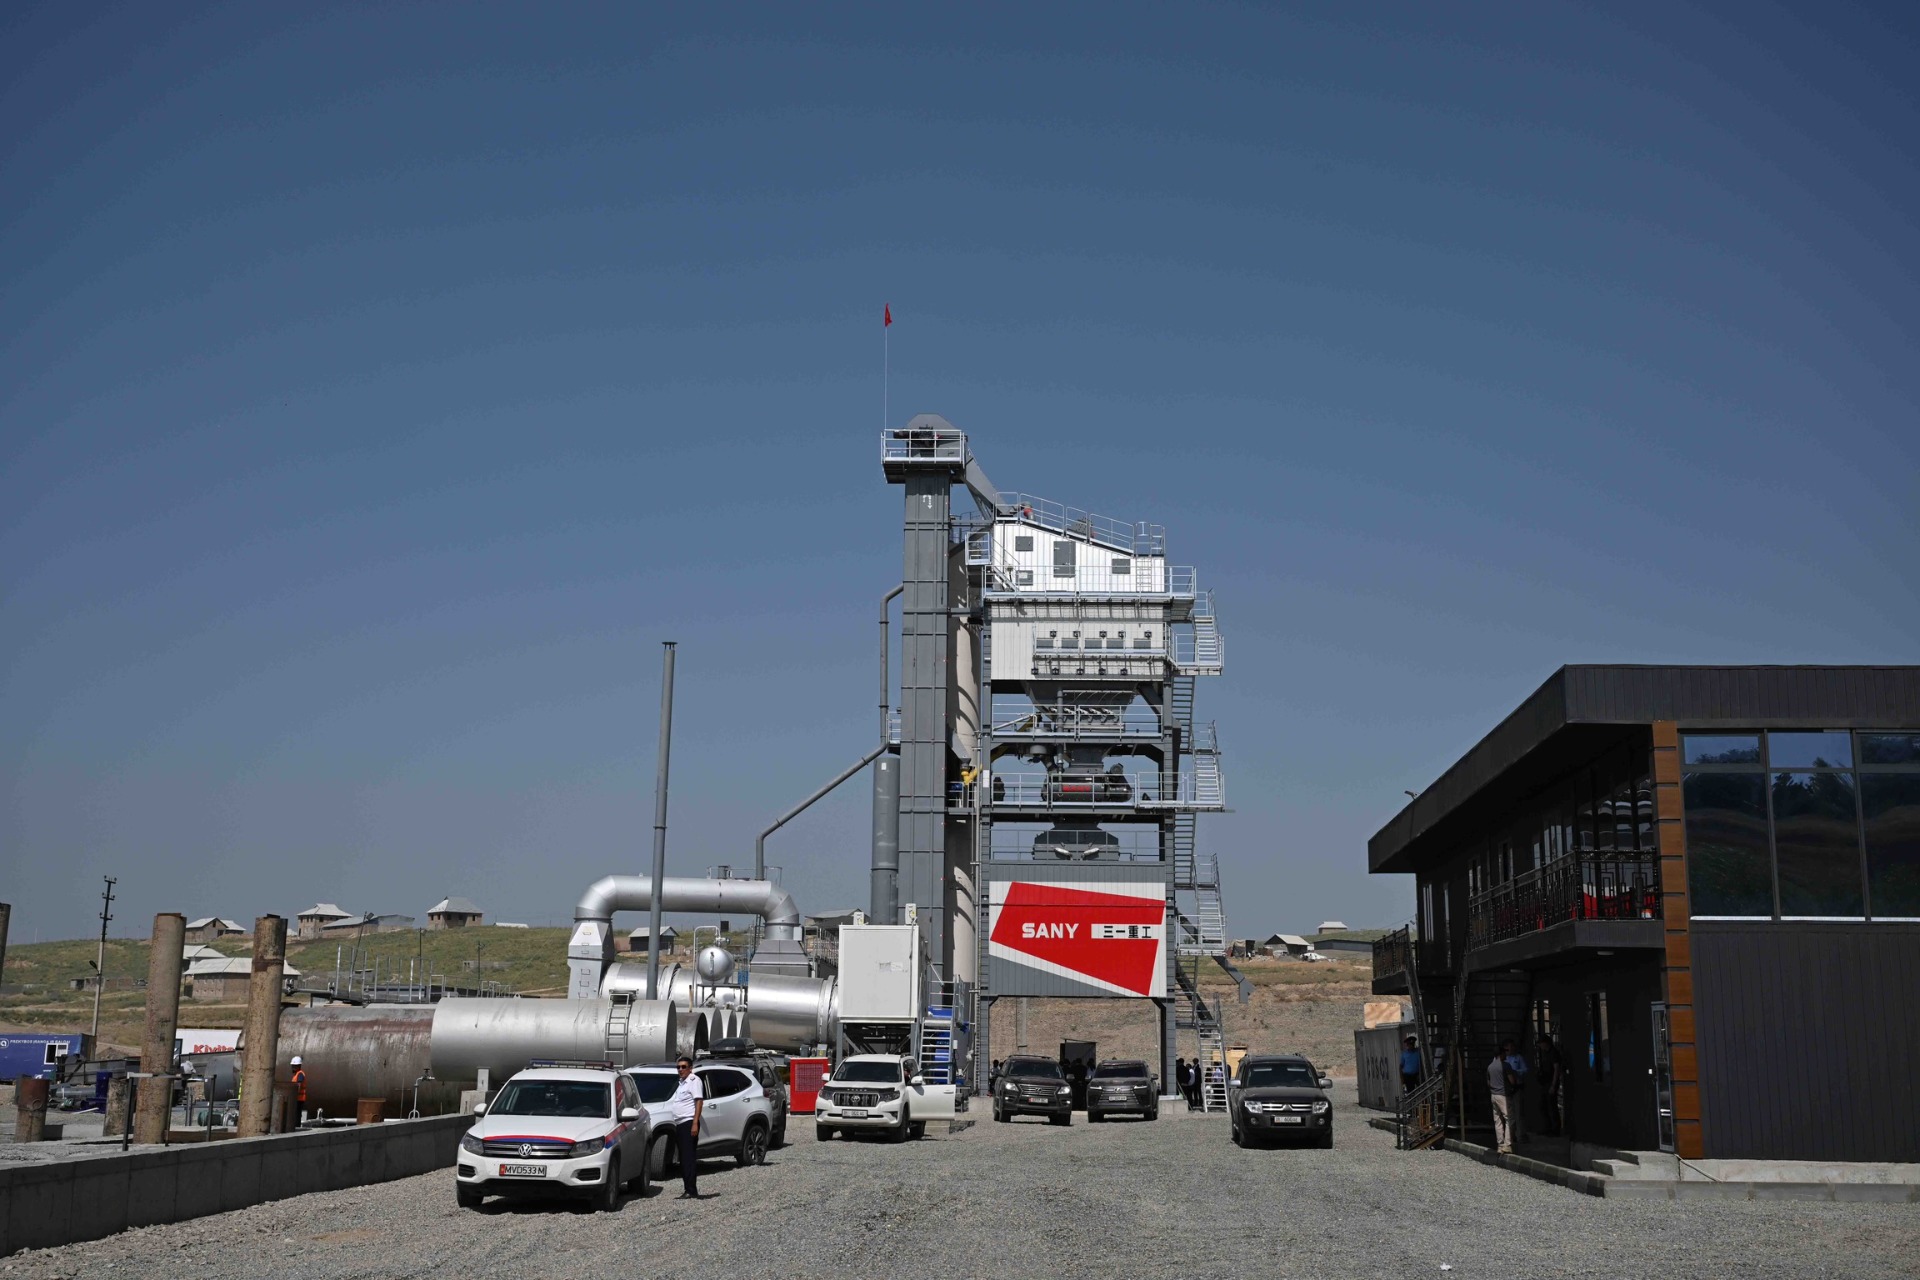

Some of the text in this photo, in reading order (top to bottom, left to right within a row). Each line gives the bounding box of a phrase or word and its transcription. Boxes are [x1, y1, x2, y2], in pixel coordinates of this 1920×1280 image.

[1021, 922, 1079, 939] SANY
[1103, 925, 1152, 938] 三一重工
